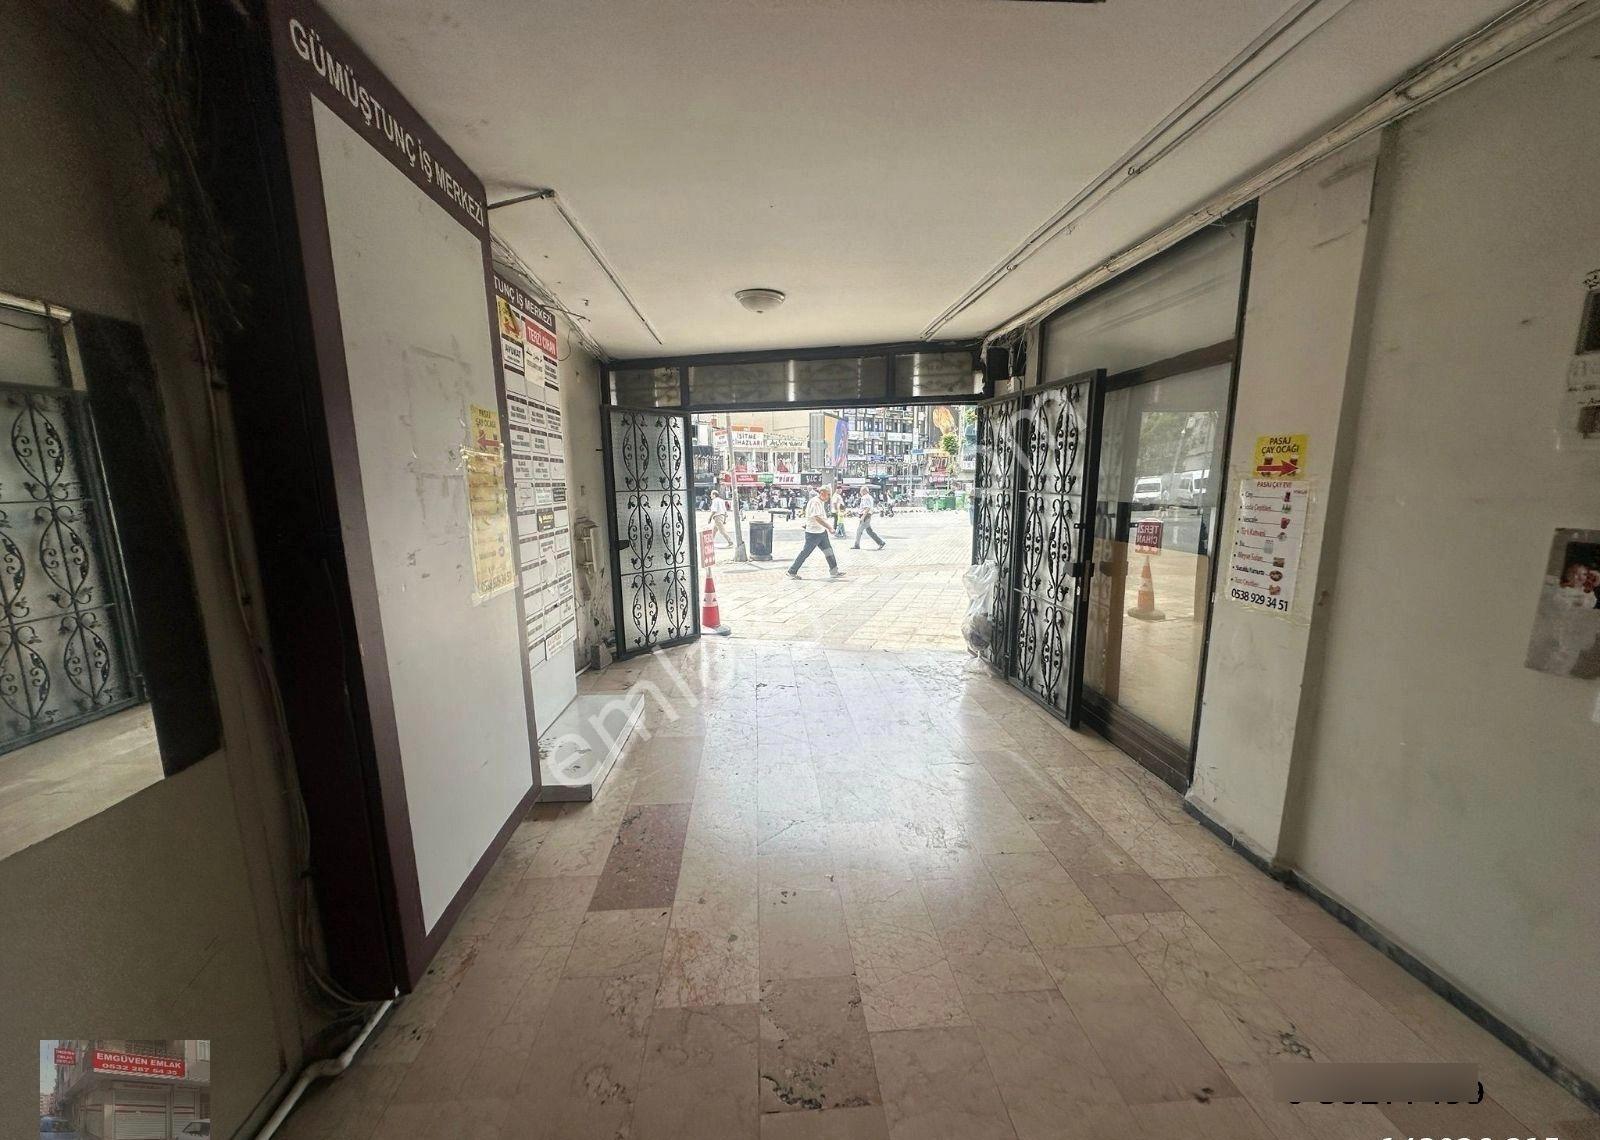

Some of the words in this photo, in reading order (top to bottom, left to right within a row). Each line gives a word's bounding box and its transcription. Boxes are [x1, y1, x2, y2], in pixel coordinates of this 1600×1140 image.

[289, 18, 415, 167] GÜMÜŞTUNÇ
[418, 139, 433, 183] İŞ
[434, 161, 484, 227] MERKEZİ
[1269, 437, 1291, 445] PASAJ
[1261, 446, 1275, 456] ÇAY
[1231, 588, 1249, 601] 0538
[1250, 593, 1265, 605] 929
[1266, 596, 1277, 608] 34
[1278, 599, 1288, 612] 51
